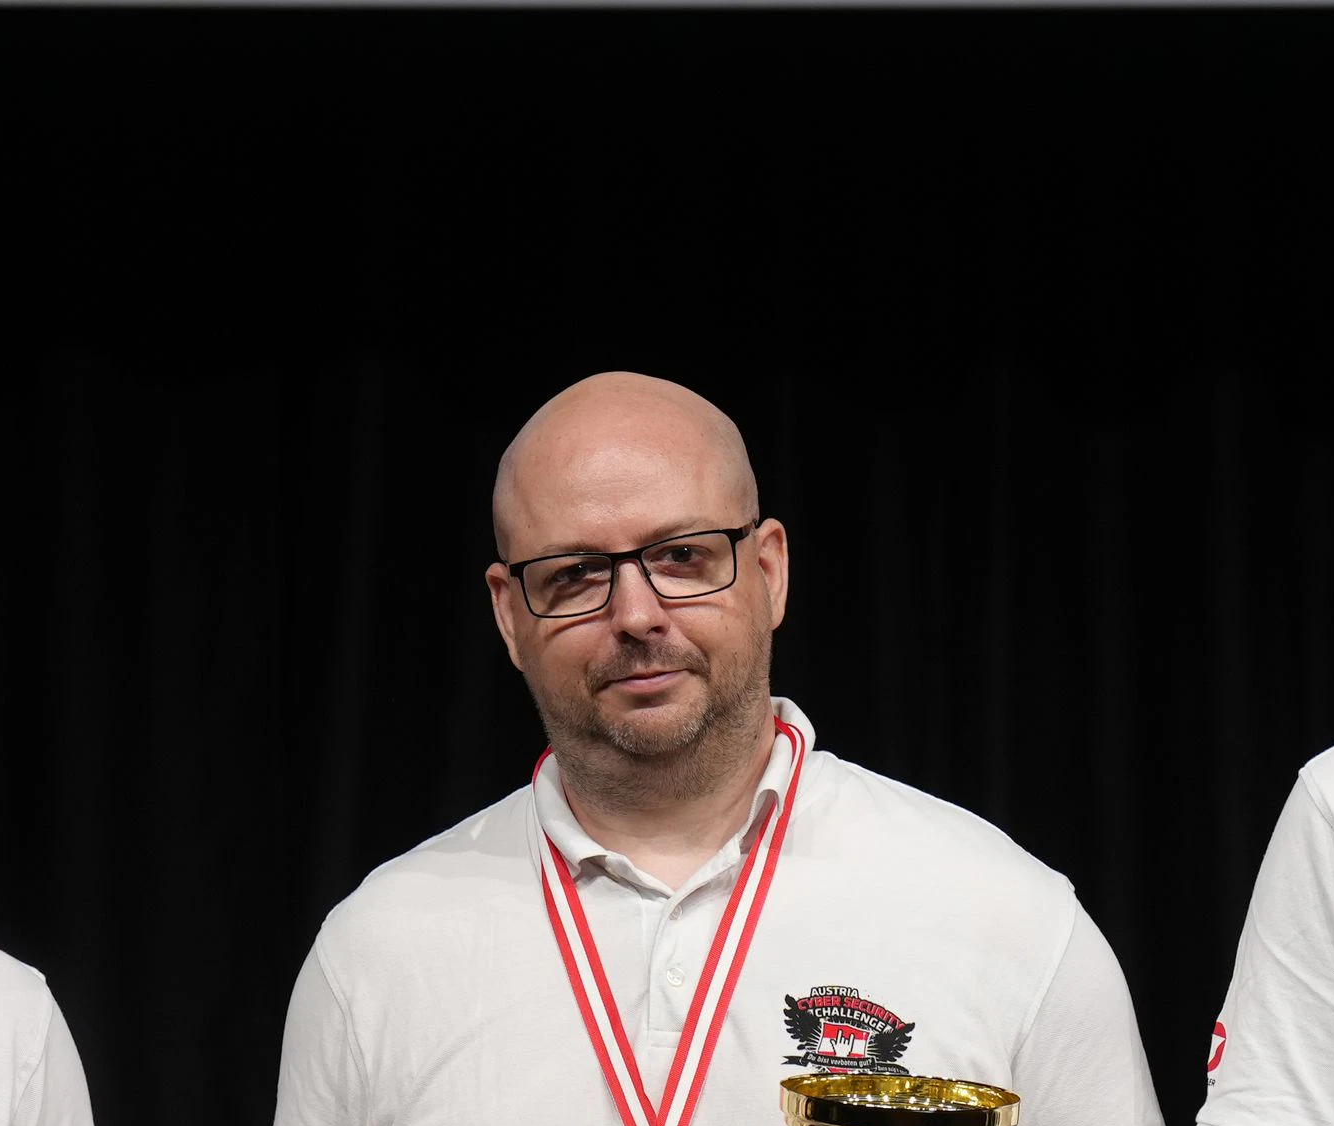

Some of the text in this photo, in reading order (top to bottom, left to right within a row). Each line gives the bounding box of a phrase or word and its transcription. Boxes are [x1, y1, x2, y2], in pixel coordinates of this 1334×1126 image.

[811, 986, 859, 998] AUSTRIA
[797, 995, 907, 1030] CYBER SECURITY
[816, 1007, 886, 1032] CHALLENGE
[806, 1053, 816, 1062] Du
[817, 1056, 830, 1064] bist
[830, 1058, 858, 1067] verboten
